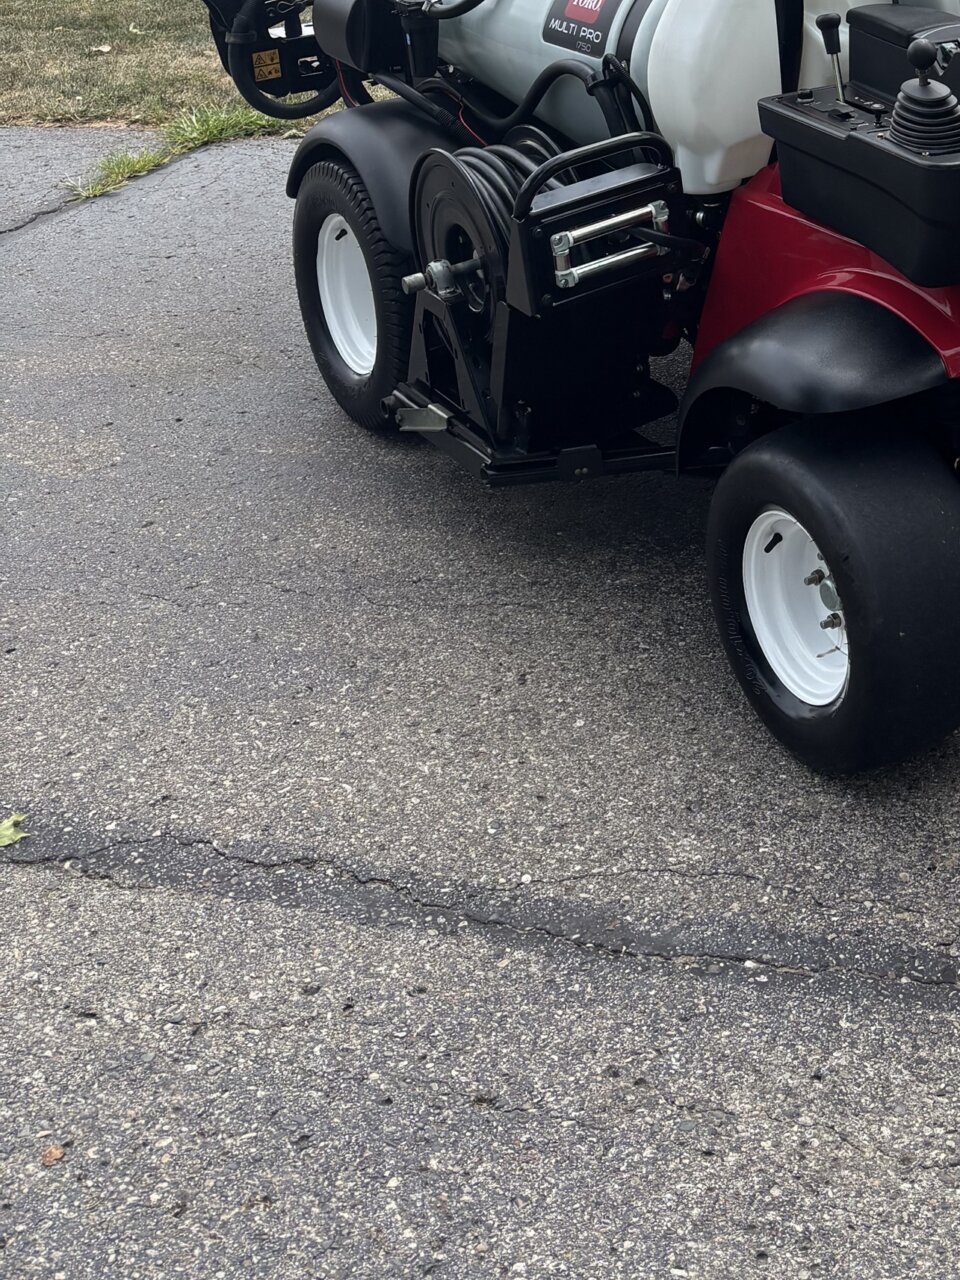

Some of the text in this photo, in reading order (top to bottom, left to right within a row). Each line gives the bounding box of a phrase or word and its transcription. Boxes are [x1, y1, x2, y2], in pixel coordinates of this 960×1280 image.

[549, 18, 602, 43] MULTI PRO
[576, 41, 592, 52] 1750
